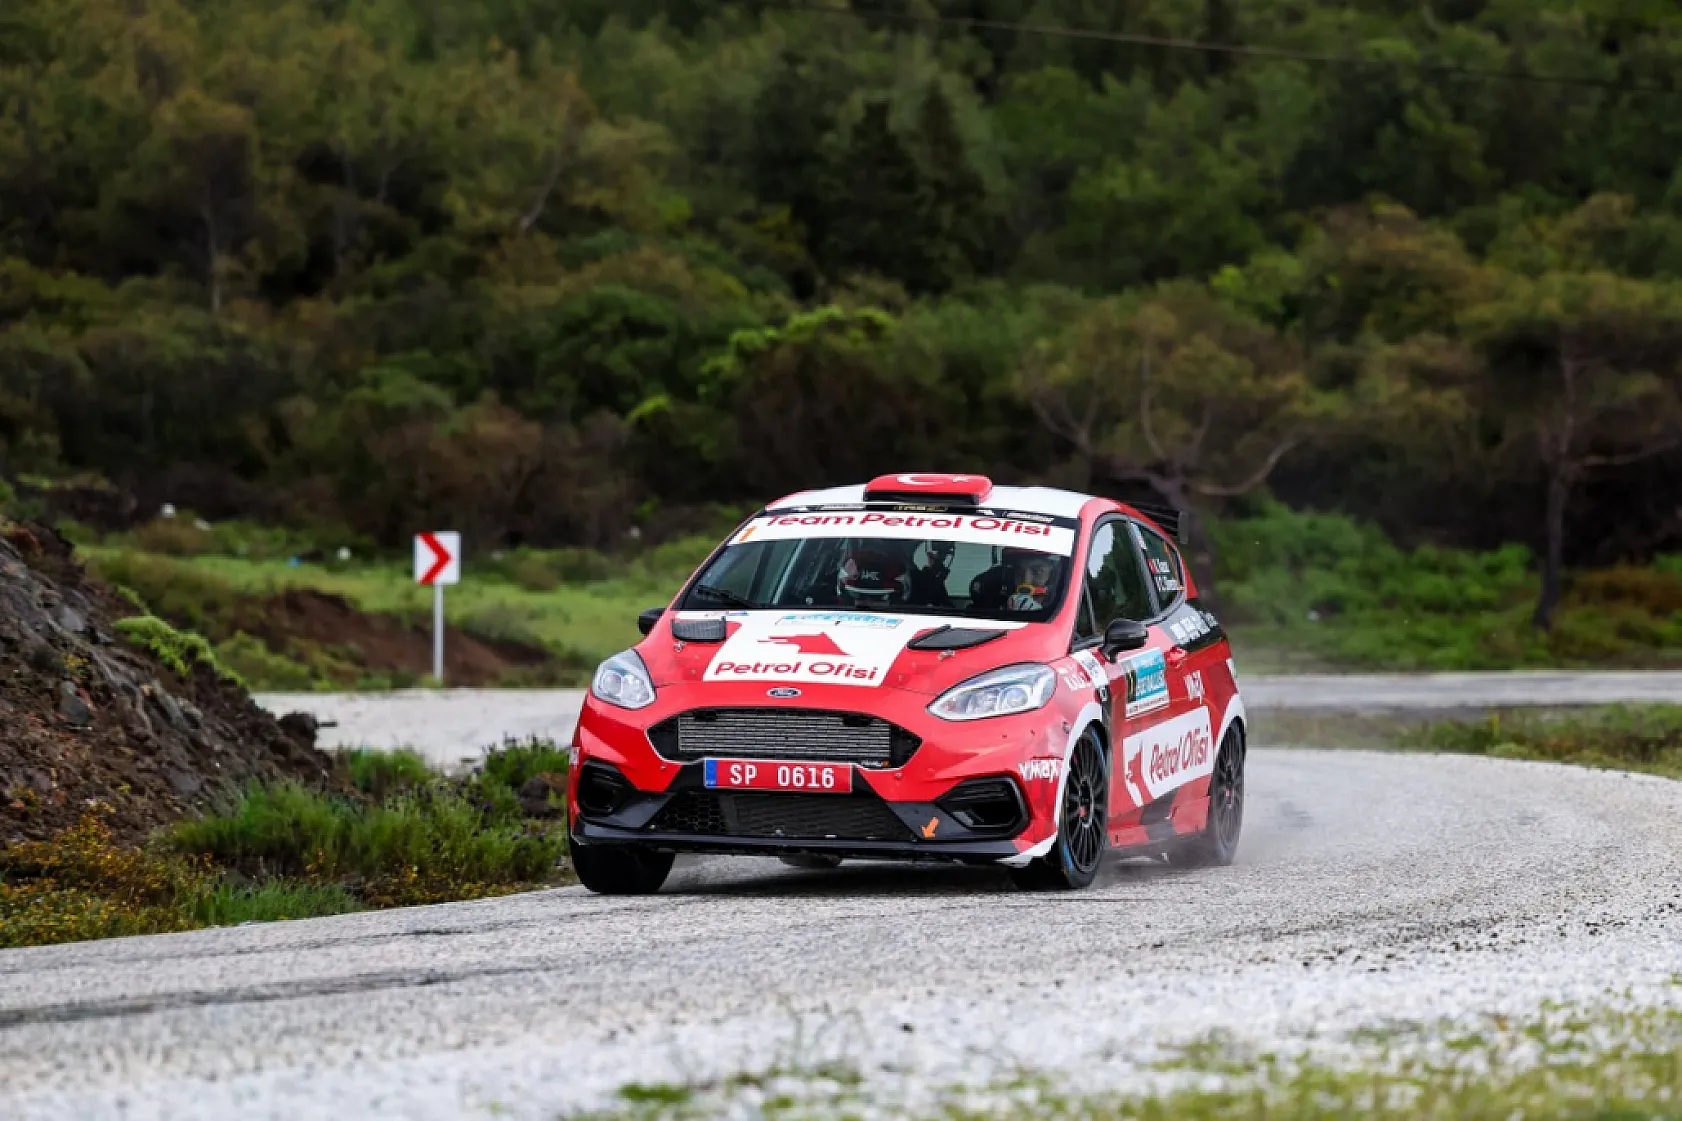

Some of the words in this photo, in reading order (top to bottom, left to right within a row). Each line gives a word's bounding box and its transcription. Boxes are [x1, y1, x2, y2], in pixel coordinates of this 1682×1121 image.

[766, 515, 855, 526] Team
[859, 512, 963, 529] Petrol
[969, 517, 1052, 536] Ofisi
[714, 661, 801, 675] Petrol
[808, 661, 878, 680] Ofisi
[1150, 736, 1183, 784] Petrol
[1182, 723, 1209, 770] Ofisi
[729, 764, 757, 785] SP
[777, 765, 834, 788] 0616
